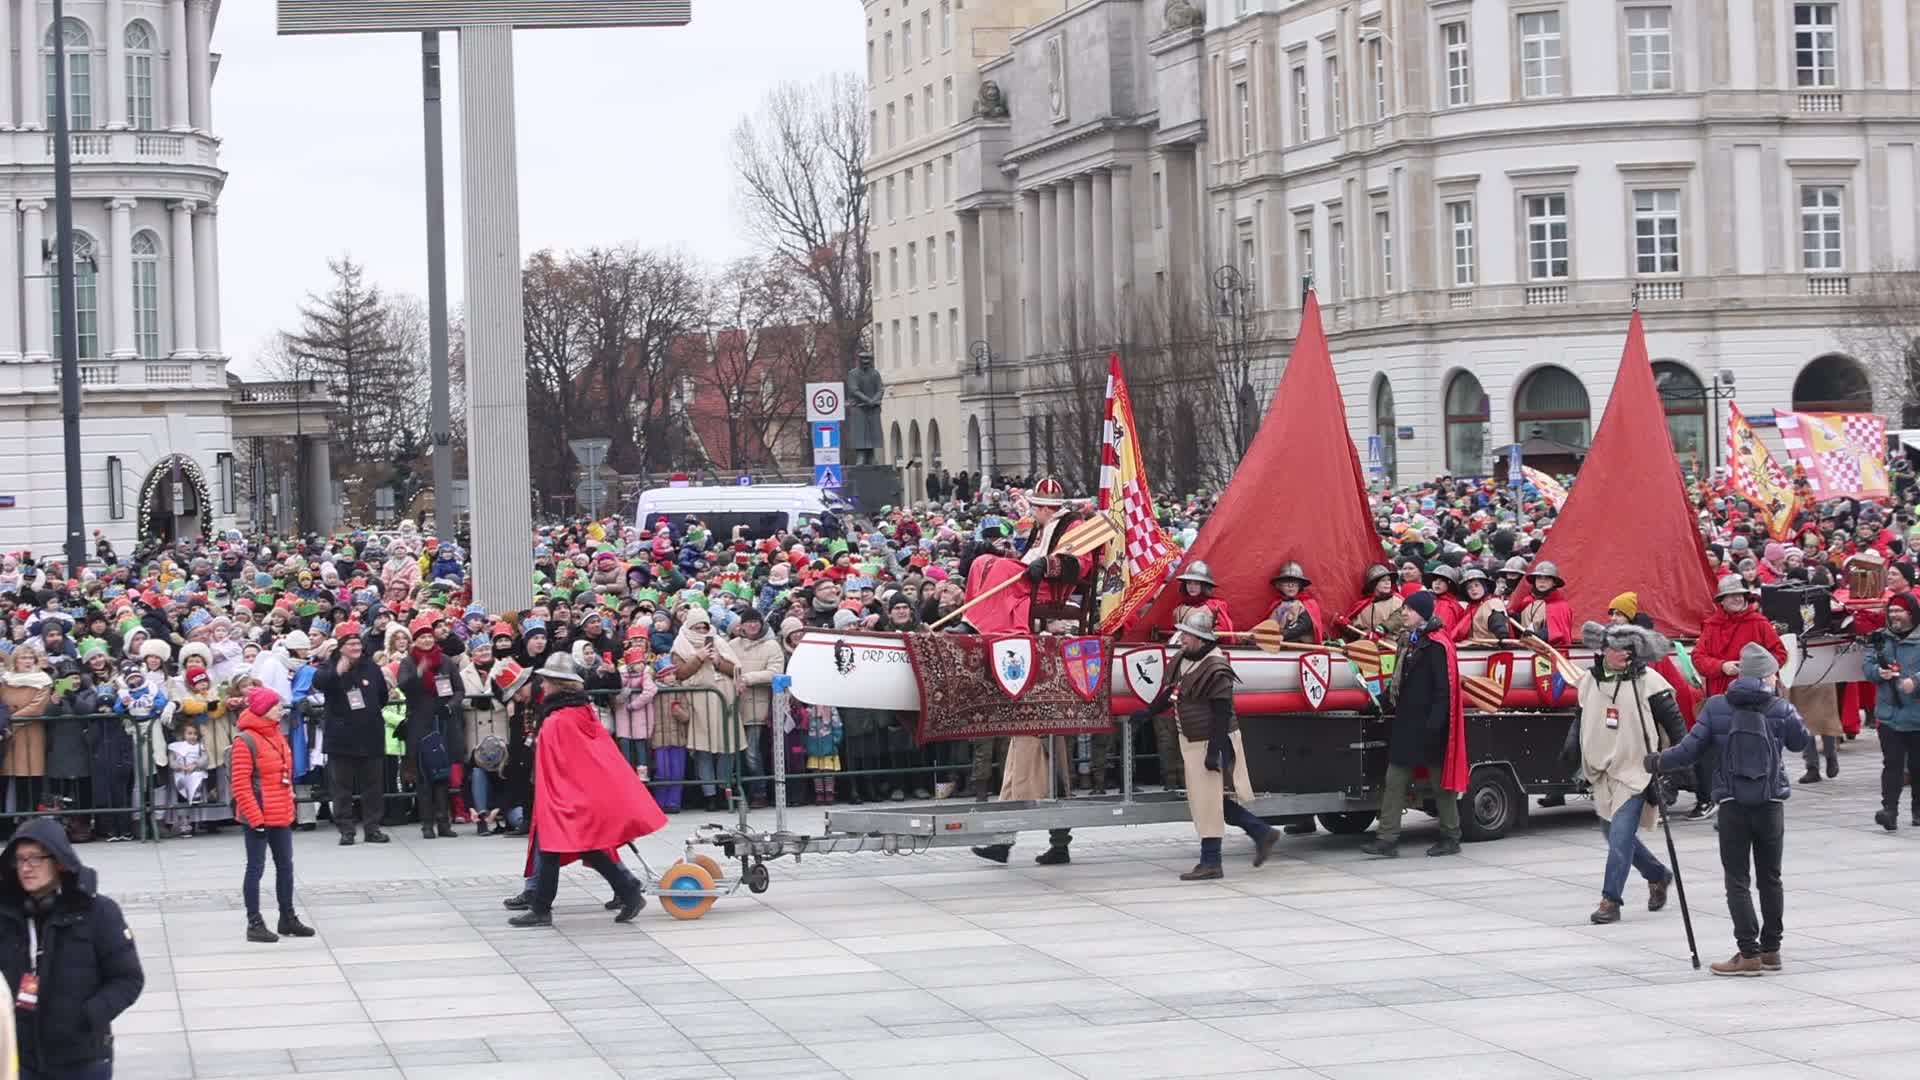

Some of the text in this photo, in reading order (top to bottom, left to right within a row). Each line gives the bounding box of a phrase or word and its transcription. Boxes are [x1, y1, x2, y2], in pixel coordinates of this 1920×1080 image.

[816, 395, 835, 408] 30
[862, 650, 884, 662] ORP
[1310, 685, 1322, 699] 10
